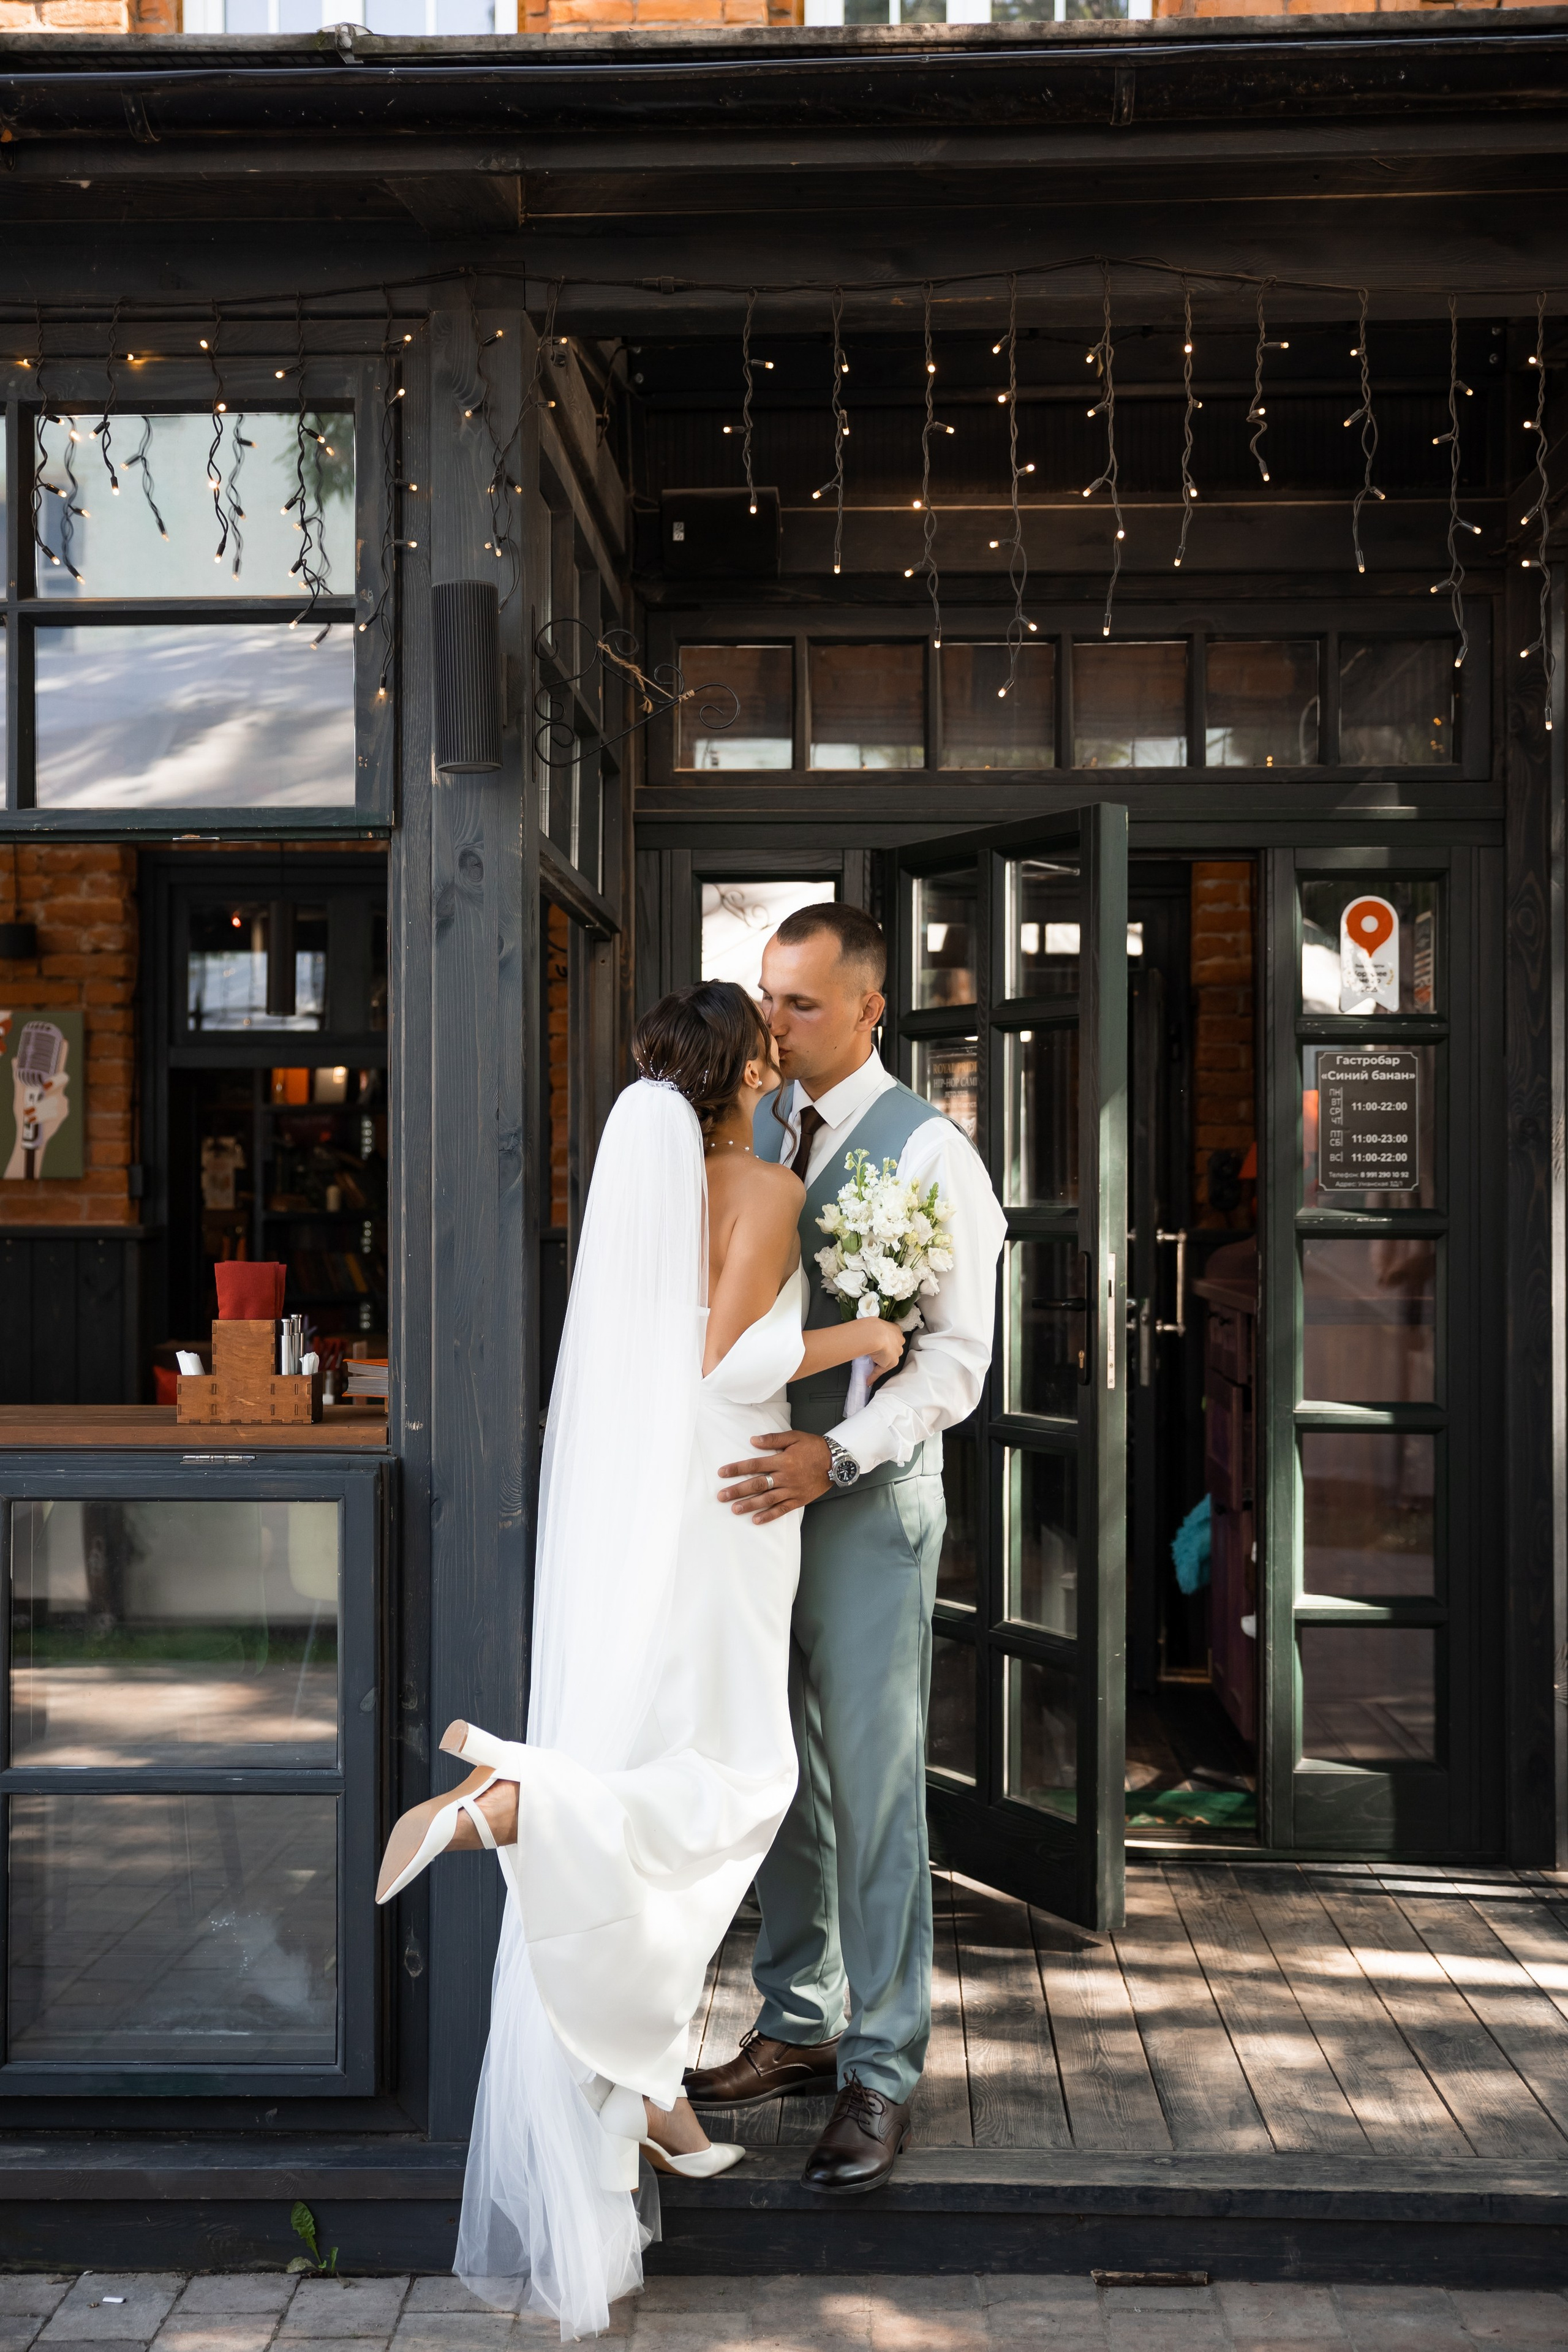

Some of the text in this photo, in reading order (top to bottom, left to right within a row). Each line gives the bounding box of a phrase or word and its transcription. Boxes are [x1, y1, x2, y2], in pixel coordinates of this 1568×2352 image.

[1336, 1055, 1401, 1066] Гастробар
[933, 1063, 956, 1074] ROYAL
[1321, 1070, 1416, 1080] «Синий банан»
[933, 1077, 960, 1088] HIP-HOP
[1331, 1098, 1341, 1106] ВТ
[1351, 1102, 1408, 1111] 11:00-22:00
[1329, 1107, 1341, 1115] СР
[1329, 1138, 1341, 1147] СБ
[1351, 1134, 1408, 1144] 11:00-23:00
[1329, 1153, 1408, 1162] ВС 11:00-22:00
